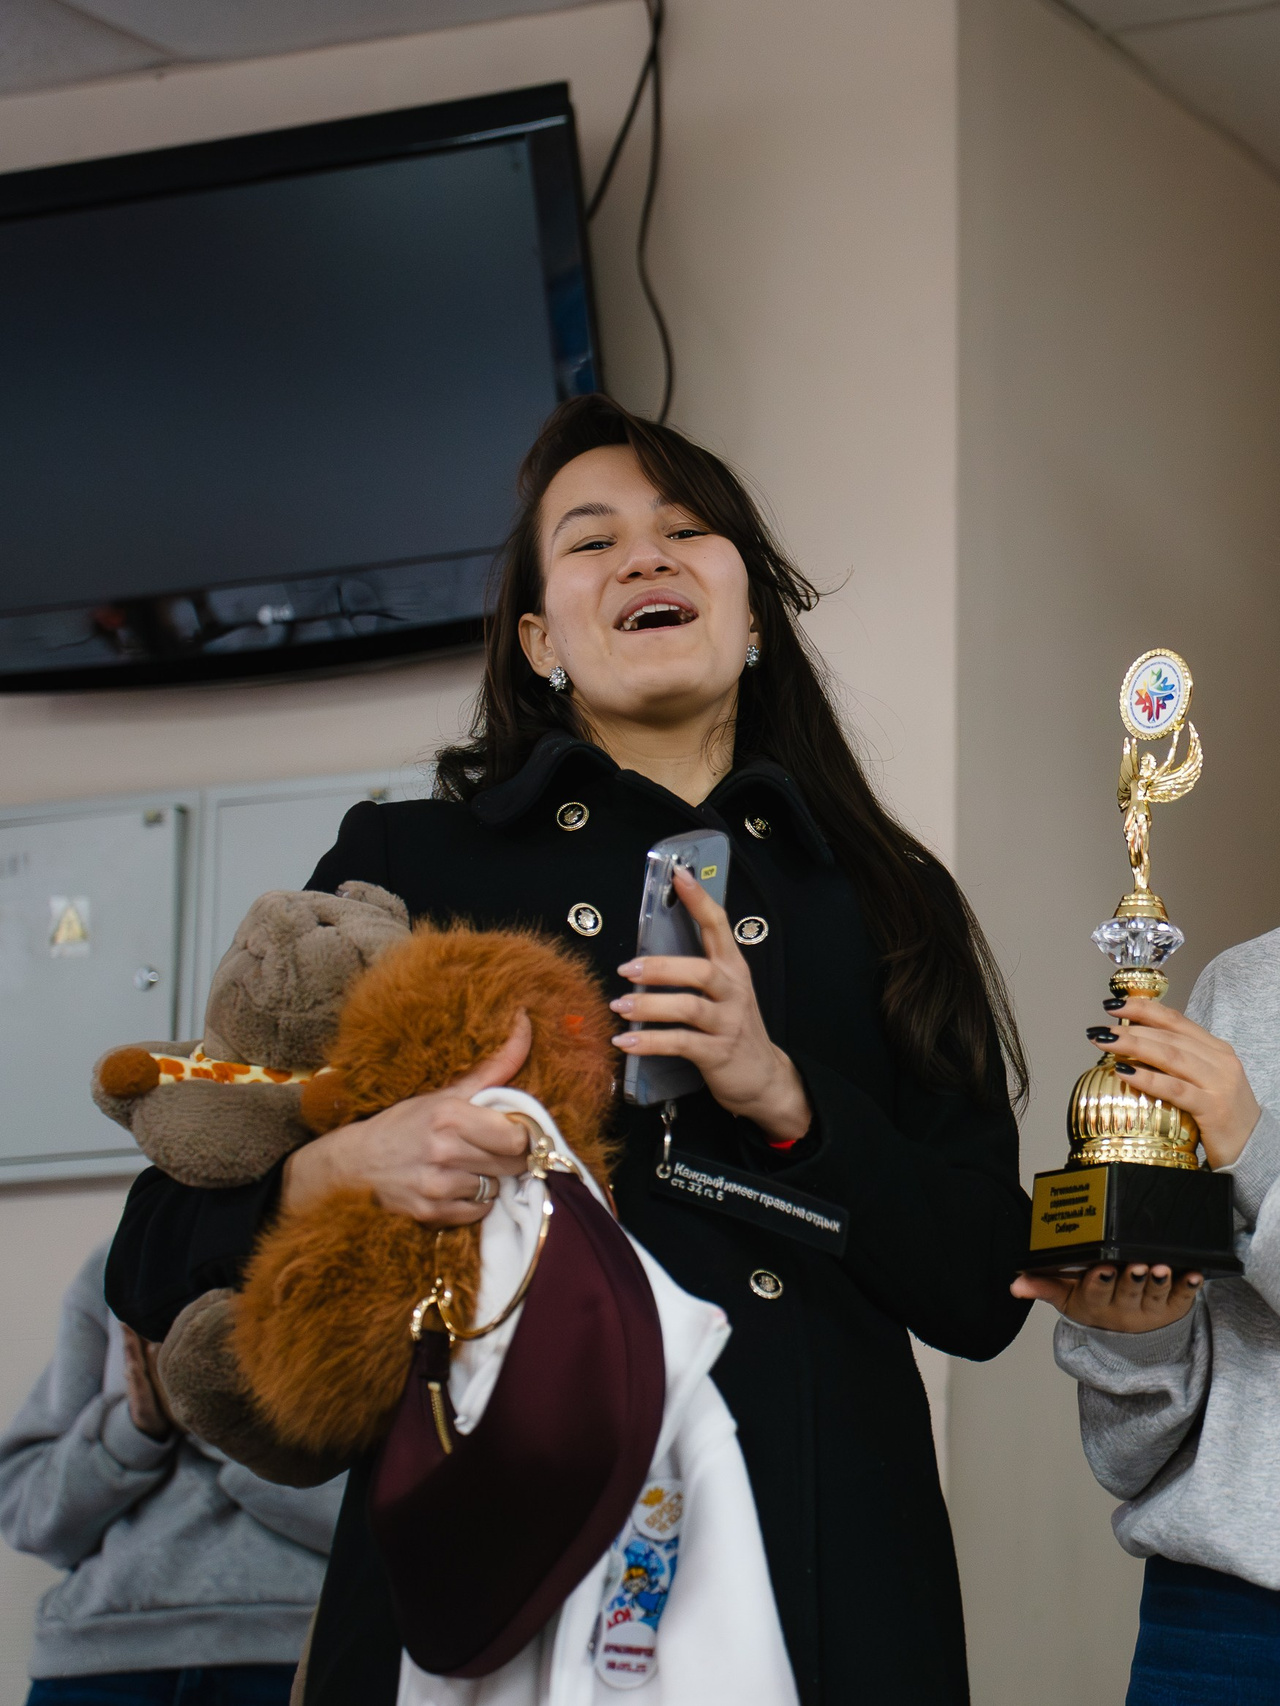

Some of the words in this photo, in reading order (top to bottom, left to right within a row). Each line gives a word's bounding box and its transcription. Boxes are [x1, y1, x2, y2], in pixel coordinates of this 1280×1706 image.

[673, 1162, 724, 1189] Каждый
[724, 1181, 759, 1201] имеет
[759, 1193, 793, 1214] право
[792, 1205, 806, 1219] на
[805, 1209, 841, 1233] отдых
